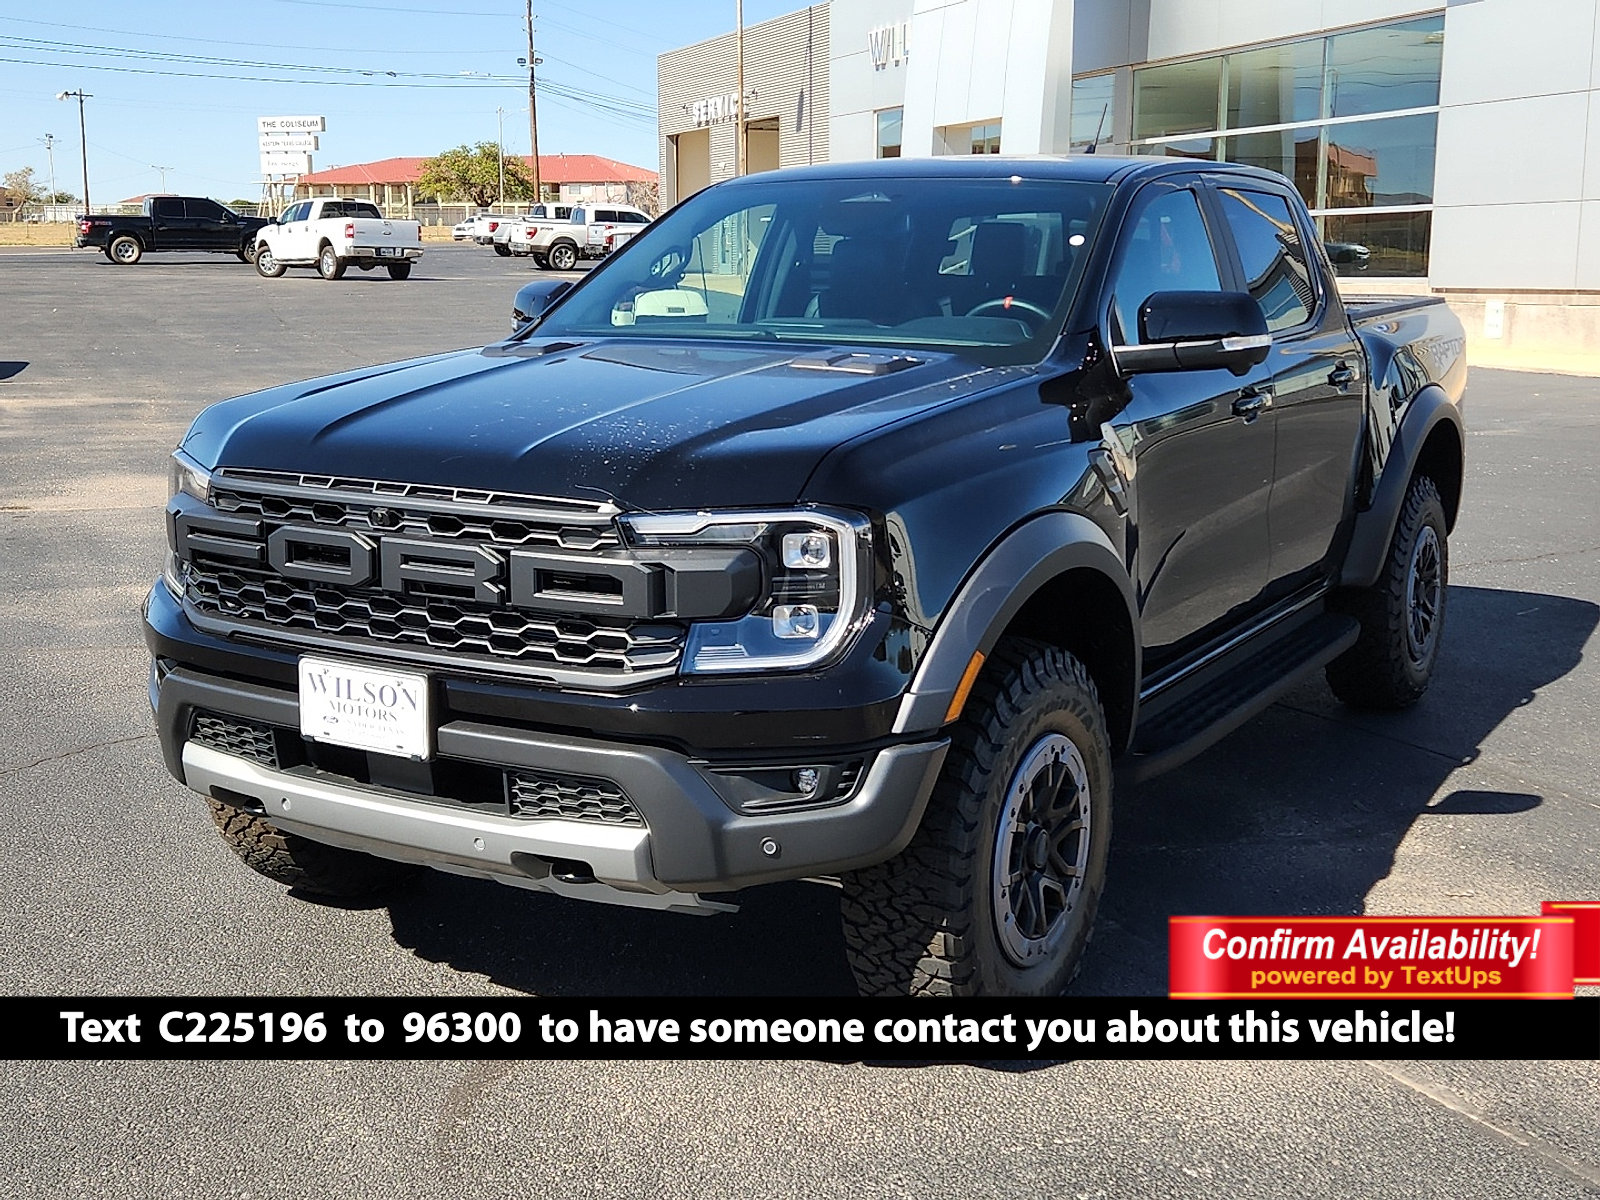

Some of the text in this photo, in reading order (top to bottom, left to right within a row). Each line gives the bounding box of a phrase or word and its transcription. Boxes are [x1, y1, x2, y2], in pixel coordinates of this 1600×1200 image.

[280, 120, 319, 128] COLISEUM
[174, 507, 668, 619] FORD
[308, 672, 417, 711] WILSON
[329, 700, 398, 722] MOTORS
